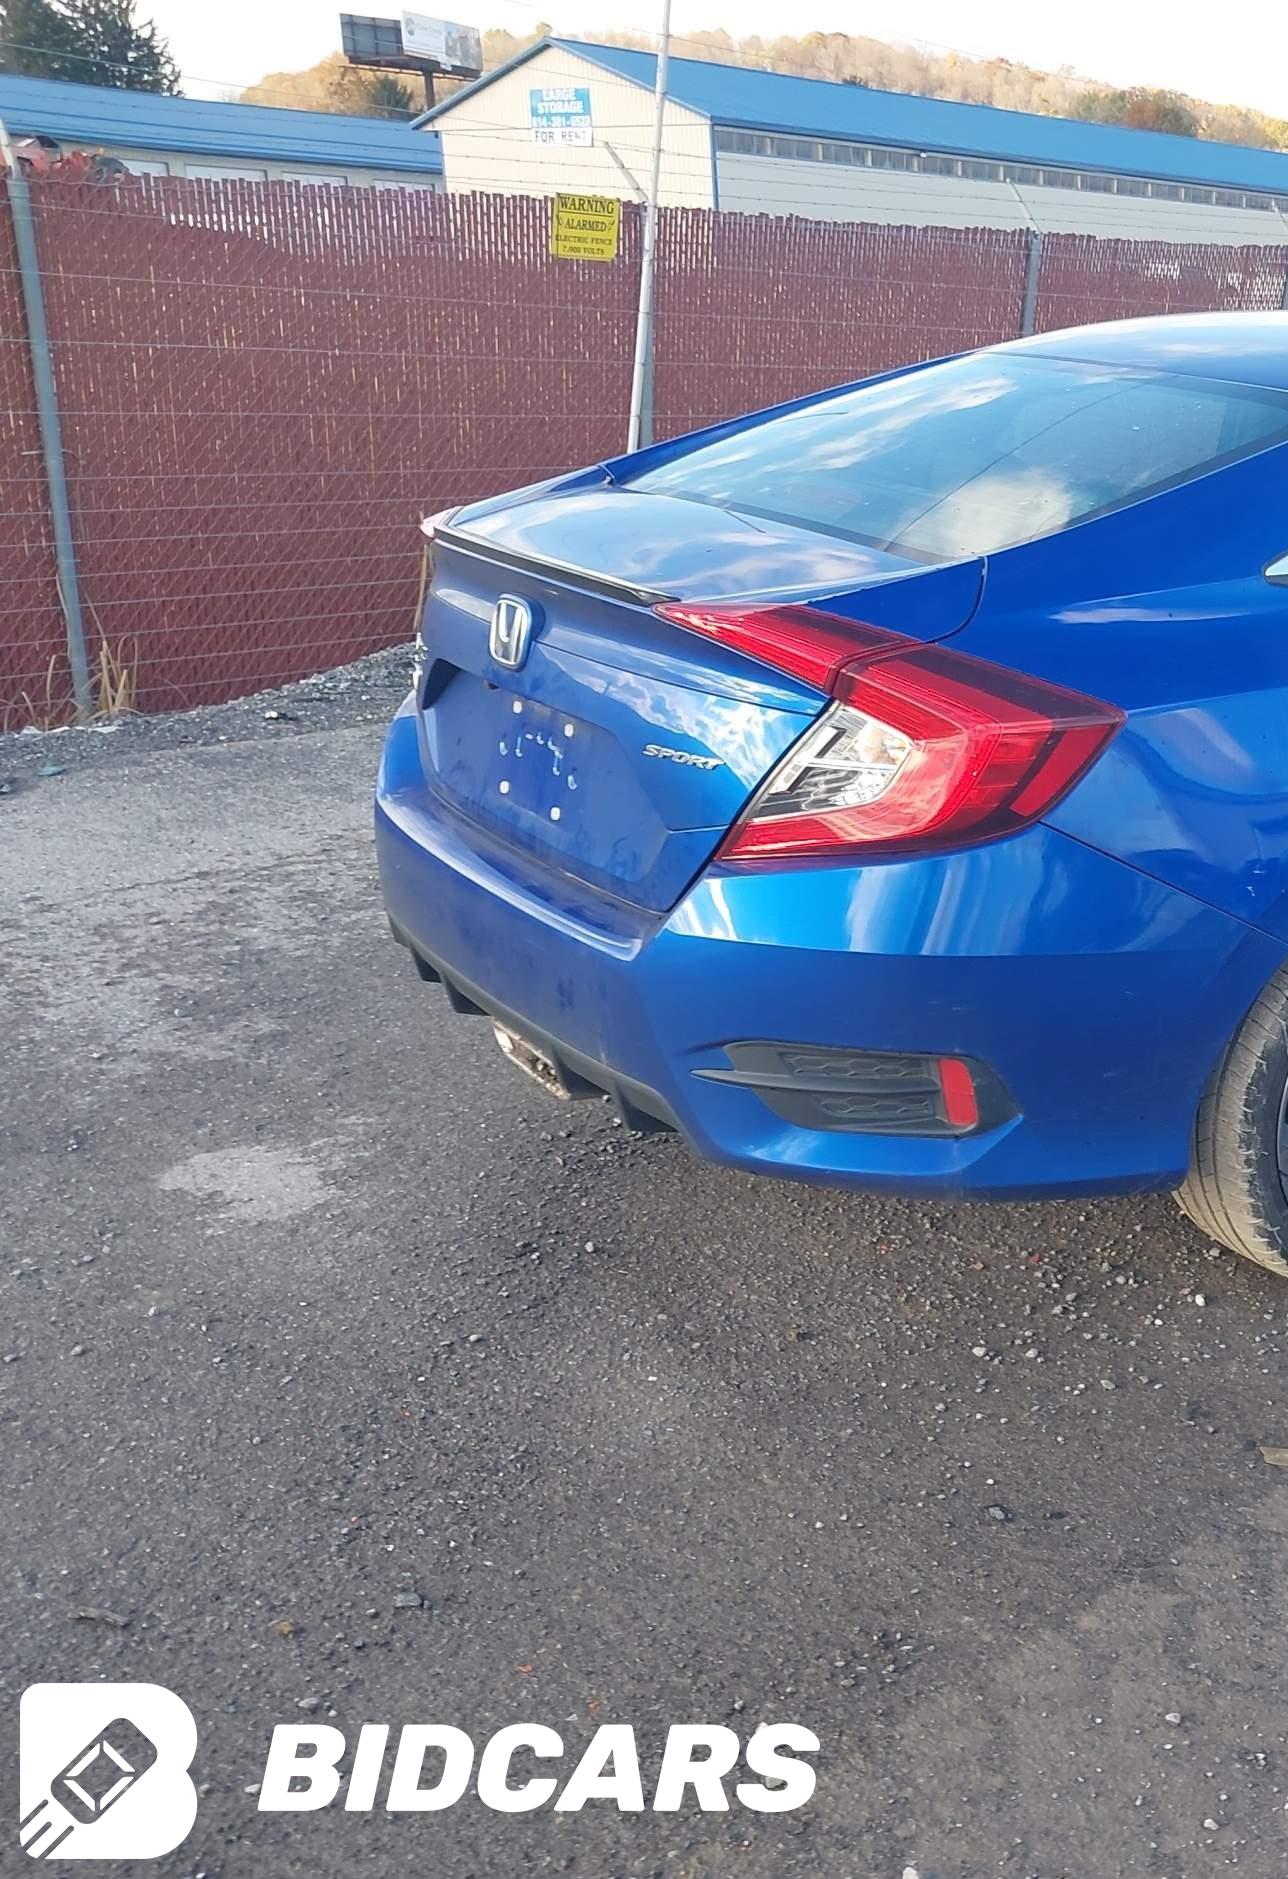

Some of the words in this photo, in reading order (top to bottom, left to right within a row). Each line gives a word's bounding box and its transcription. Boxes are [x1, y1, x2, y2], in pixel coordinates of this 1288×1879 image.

[542, 88, 577, 101] LARGE
[537, 101, 584, 114] STORAGE
[535, 130, 555, 143] FOR
[561, 130, 587, 143] RENT
[559, 196, 615, 214] WARNING
[565, 218, 607, 232] ALARMED
[556, 234, 590, 245] ELECTRIC
[591, 237, 612, 246] FENCE
[583, 247, 605, 255] VOLTS
[642, 744, 726, 771] SPORT
